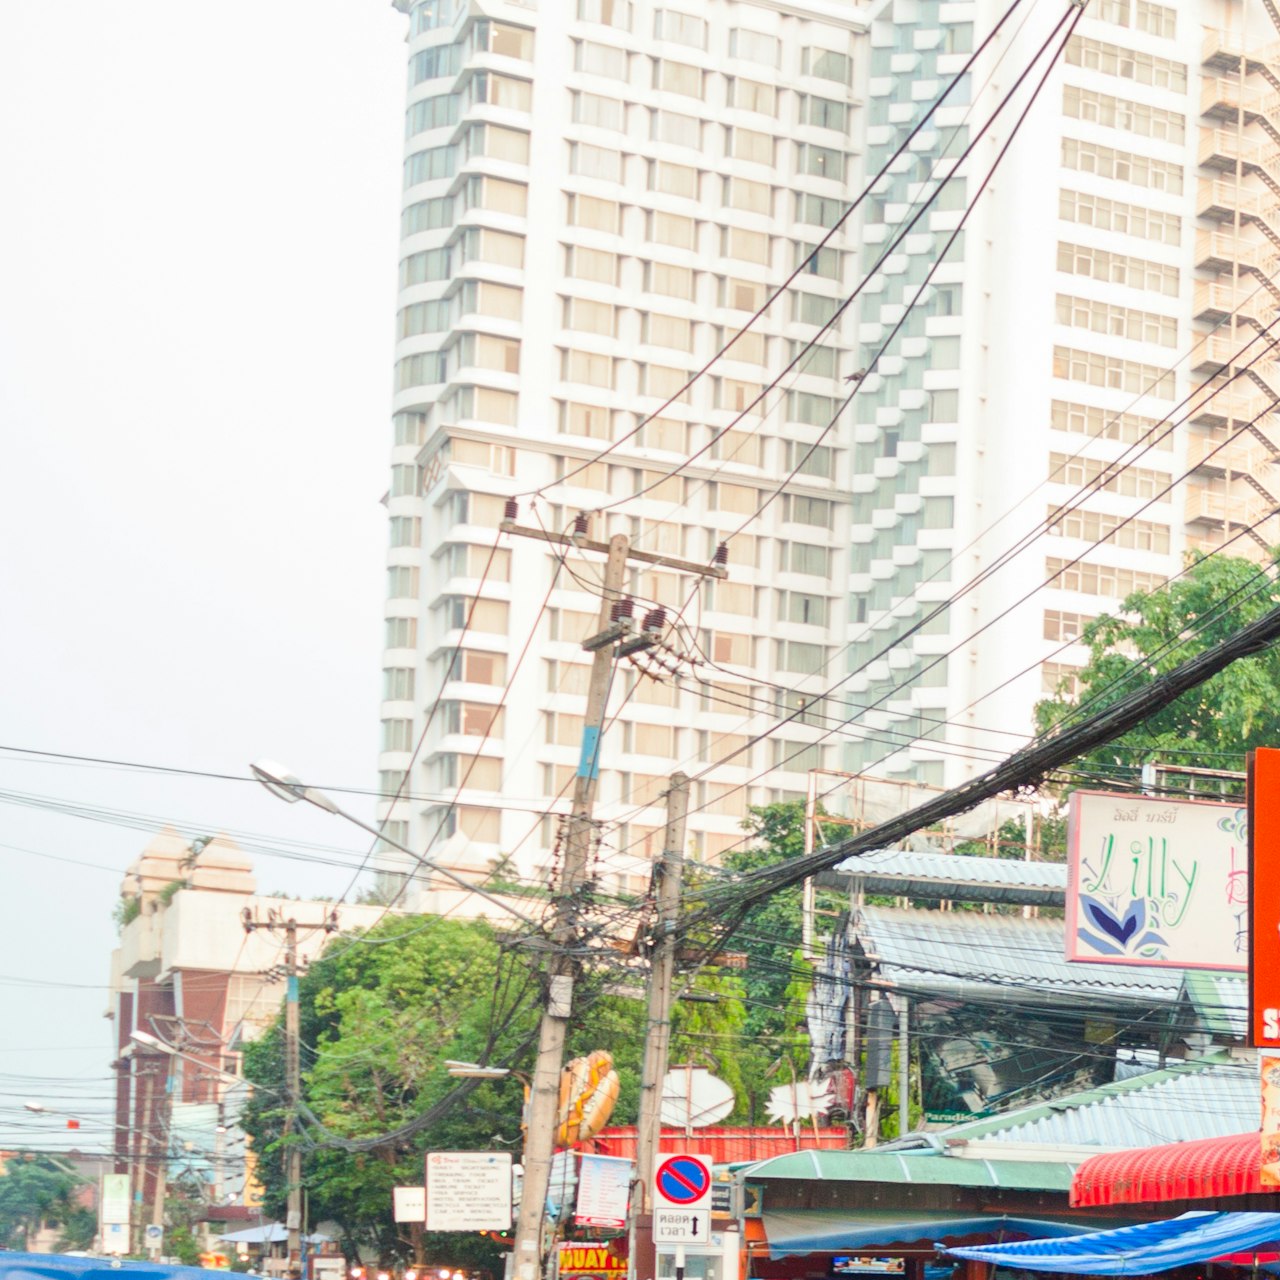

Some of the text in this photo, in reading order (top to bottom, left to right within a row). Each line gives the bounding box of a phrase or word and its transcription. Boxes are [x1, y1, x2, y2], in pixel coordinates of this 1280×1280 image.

[1087, 833, 1197, 927] Lilly
[660, 1215, 689, 1224] ตลอด
[661, 1227, 685, 1236] เวลา
[560, 1249, 608, 1268] MUAY
